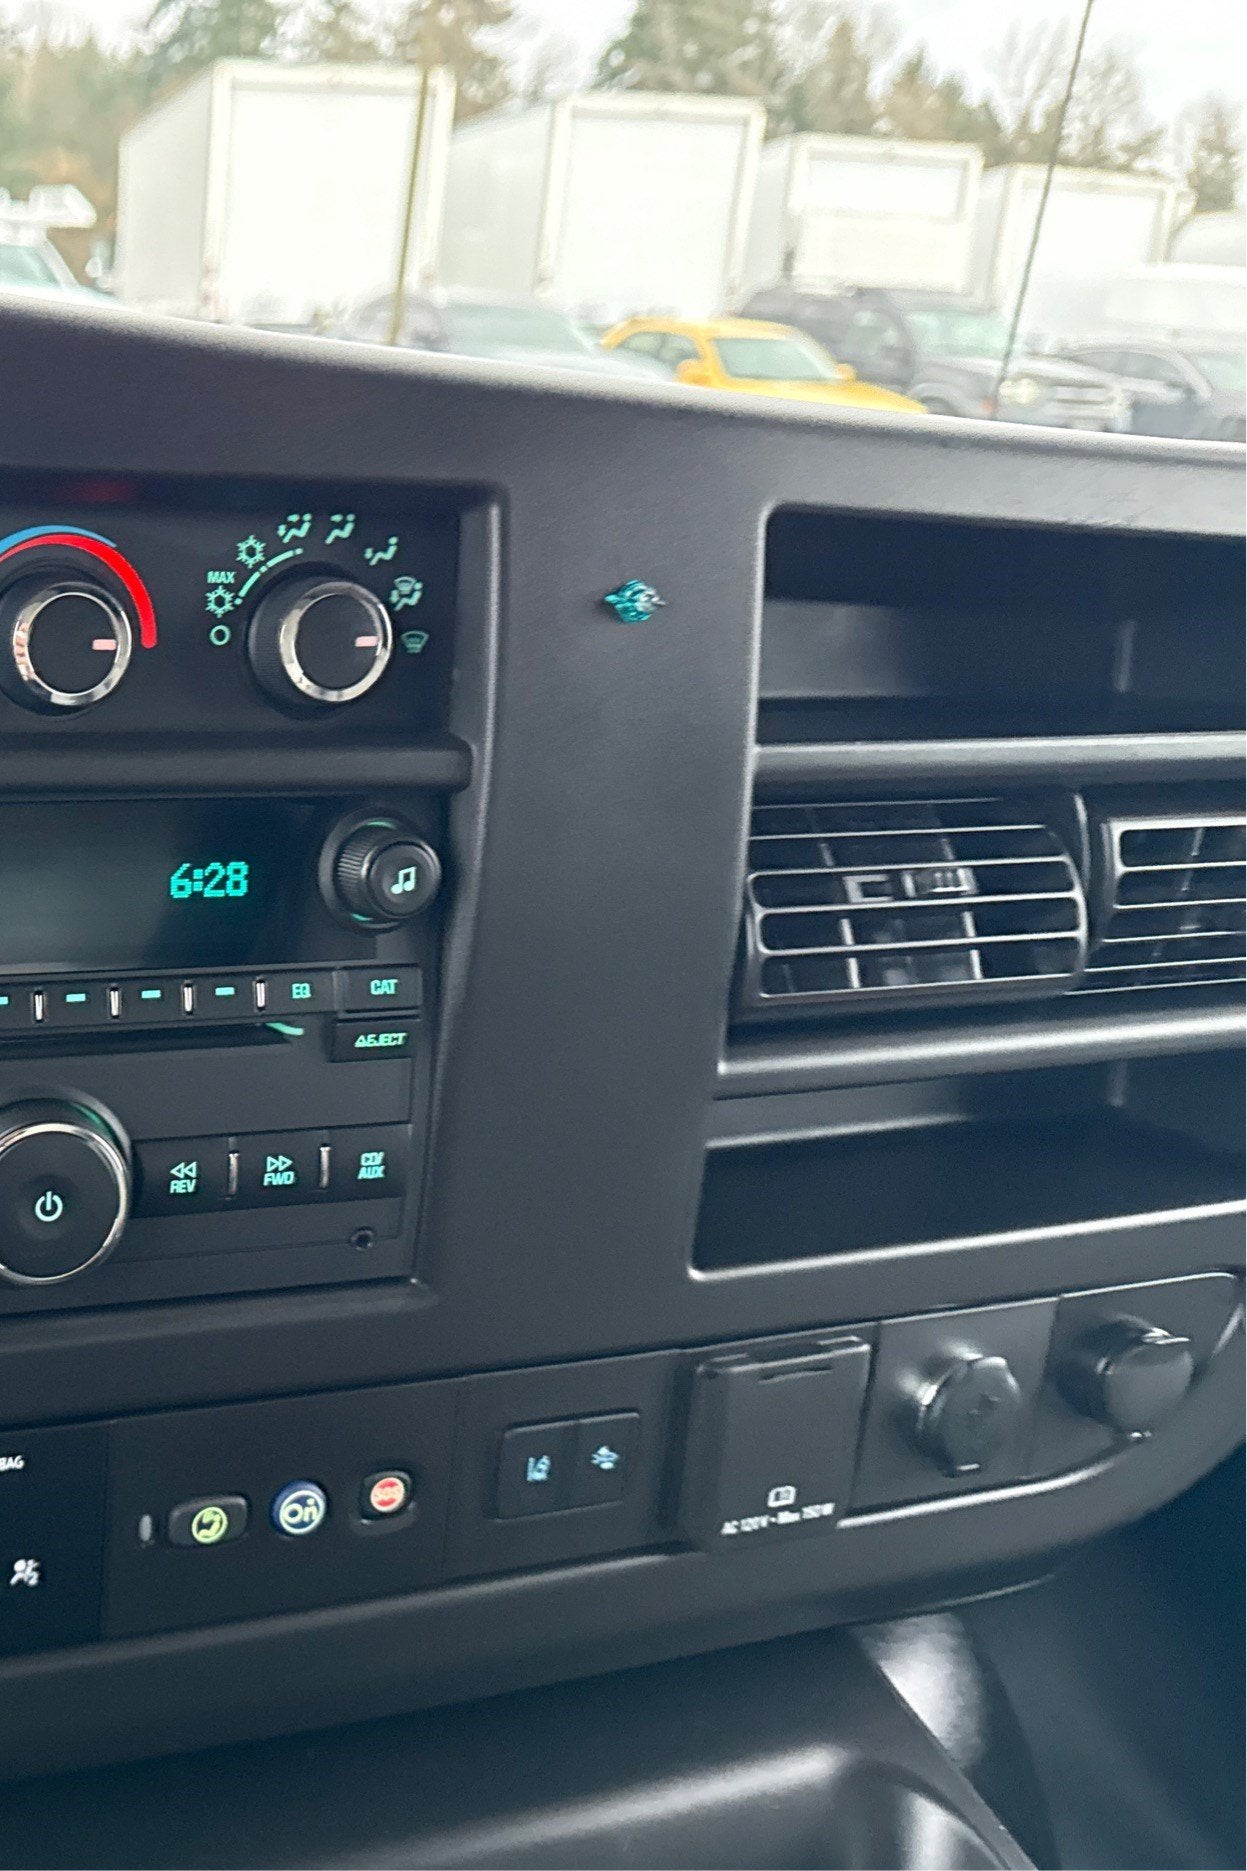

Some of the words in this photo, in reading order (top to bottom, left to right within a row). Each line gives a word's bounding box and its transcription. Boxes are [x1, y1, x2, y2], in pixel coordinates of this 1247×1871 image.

[207, 570, 236, 584] MAX
[170, 861, 249, 899] 6:28
[291, 982, 312, 999] EQ
[370, 978, 399, 996] CAT
[263, 1170, 295, 1186] FWD
[357, 1165, 385, 1180] AUX
[169, 1178, 197, 1194] REV
